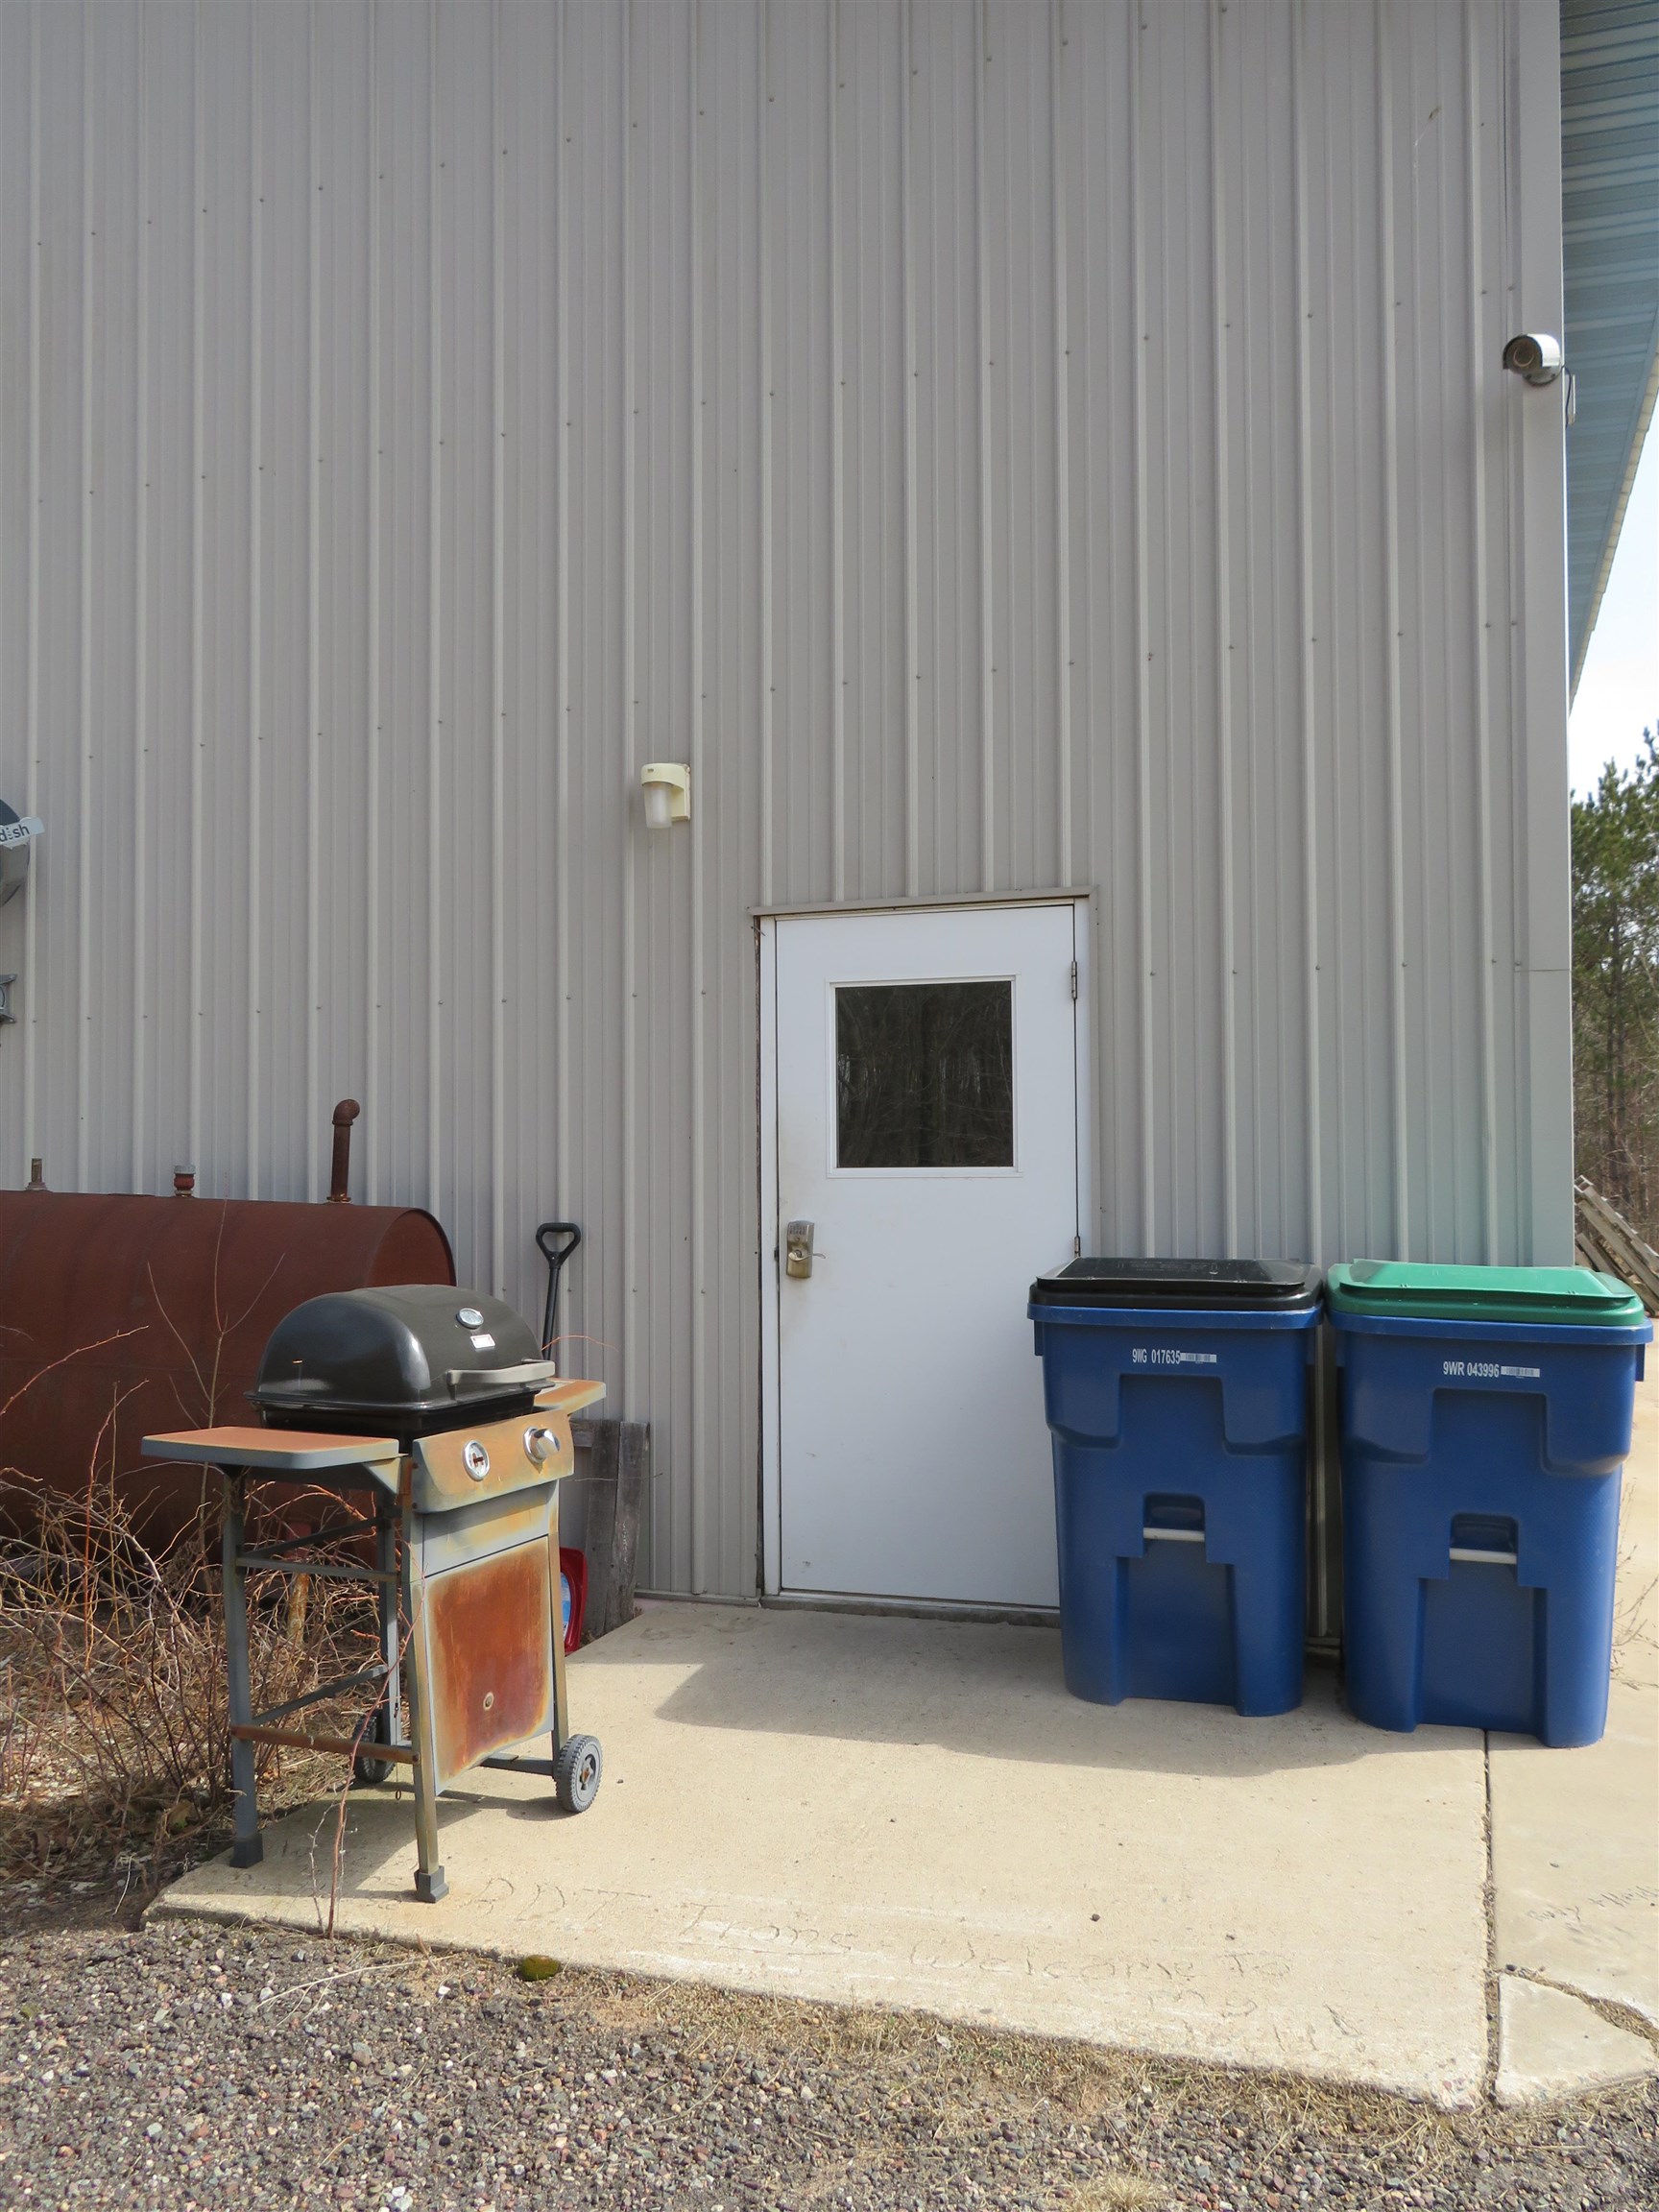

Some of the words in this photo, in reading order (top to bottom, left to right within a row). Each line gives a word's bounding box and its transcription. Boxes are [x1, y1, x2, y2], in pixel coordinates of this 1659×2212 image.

[1132, 1348, 1147, 1363] 9WG
[1151, 1349, 1181, 1364] 017635
[1443, 1360, 1465, 1376] 9WR
[1467, 1362, 1500, 1378] 043996
